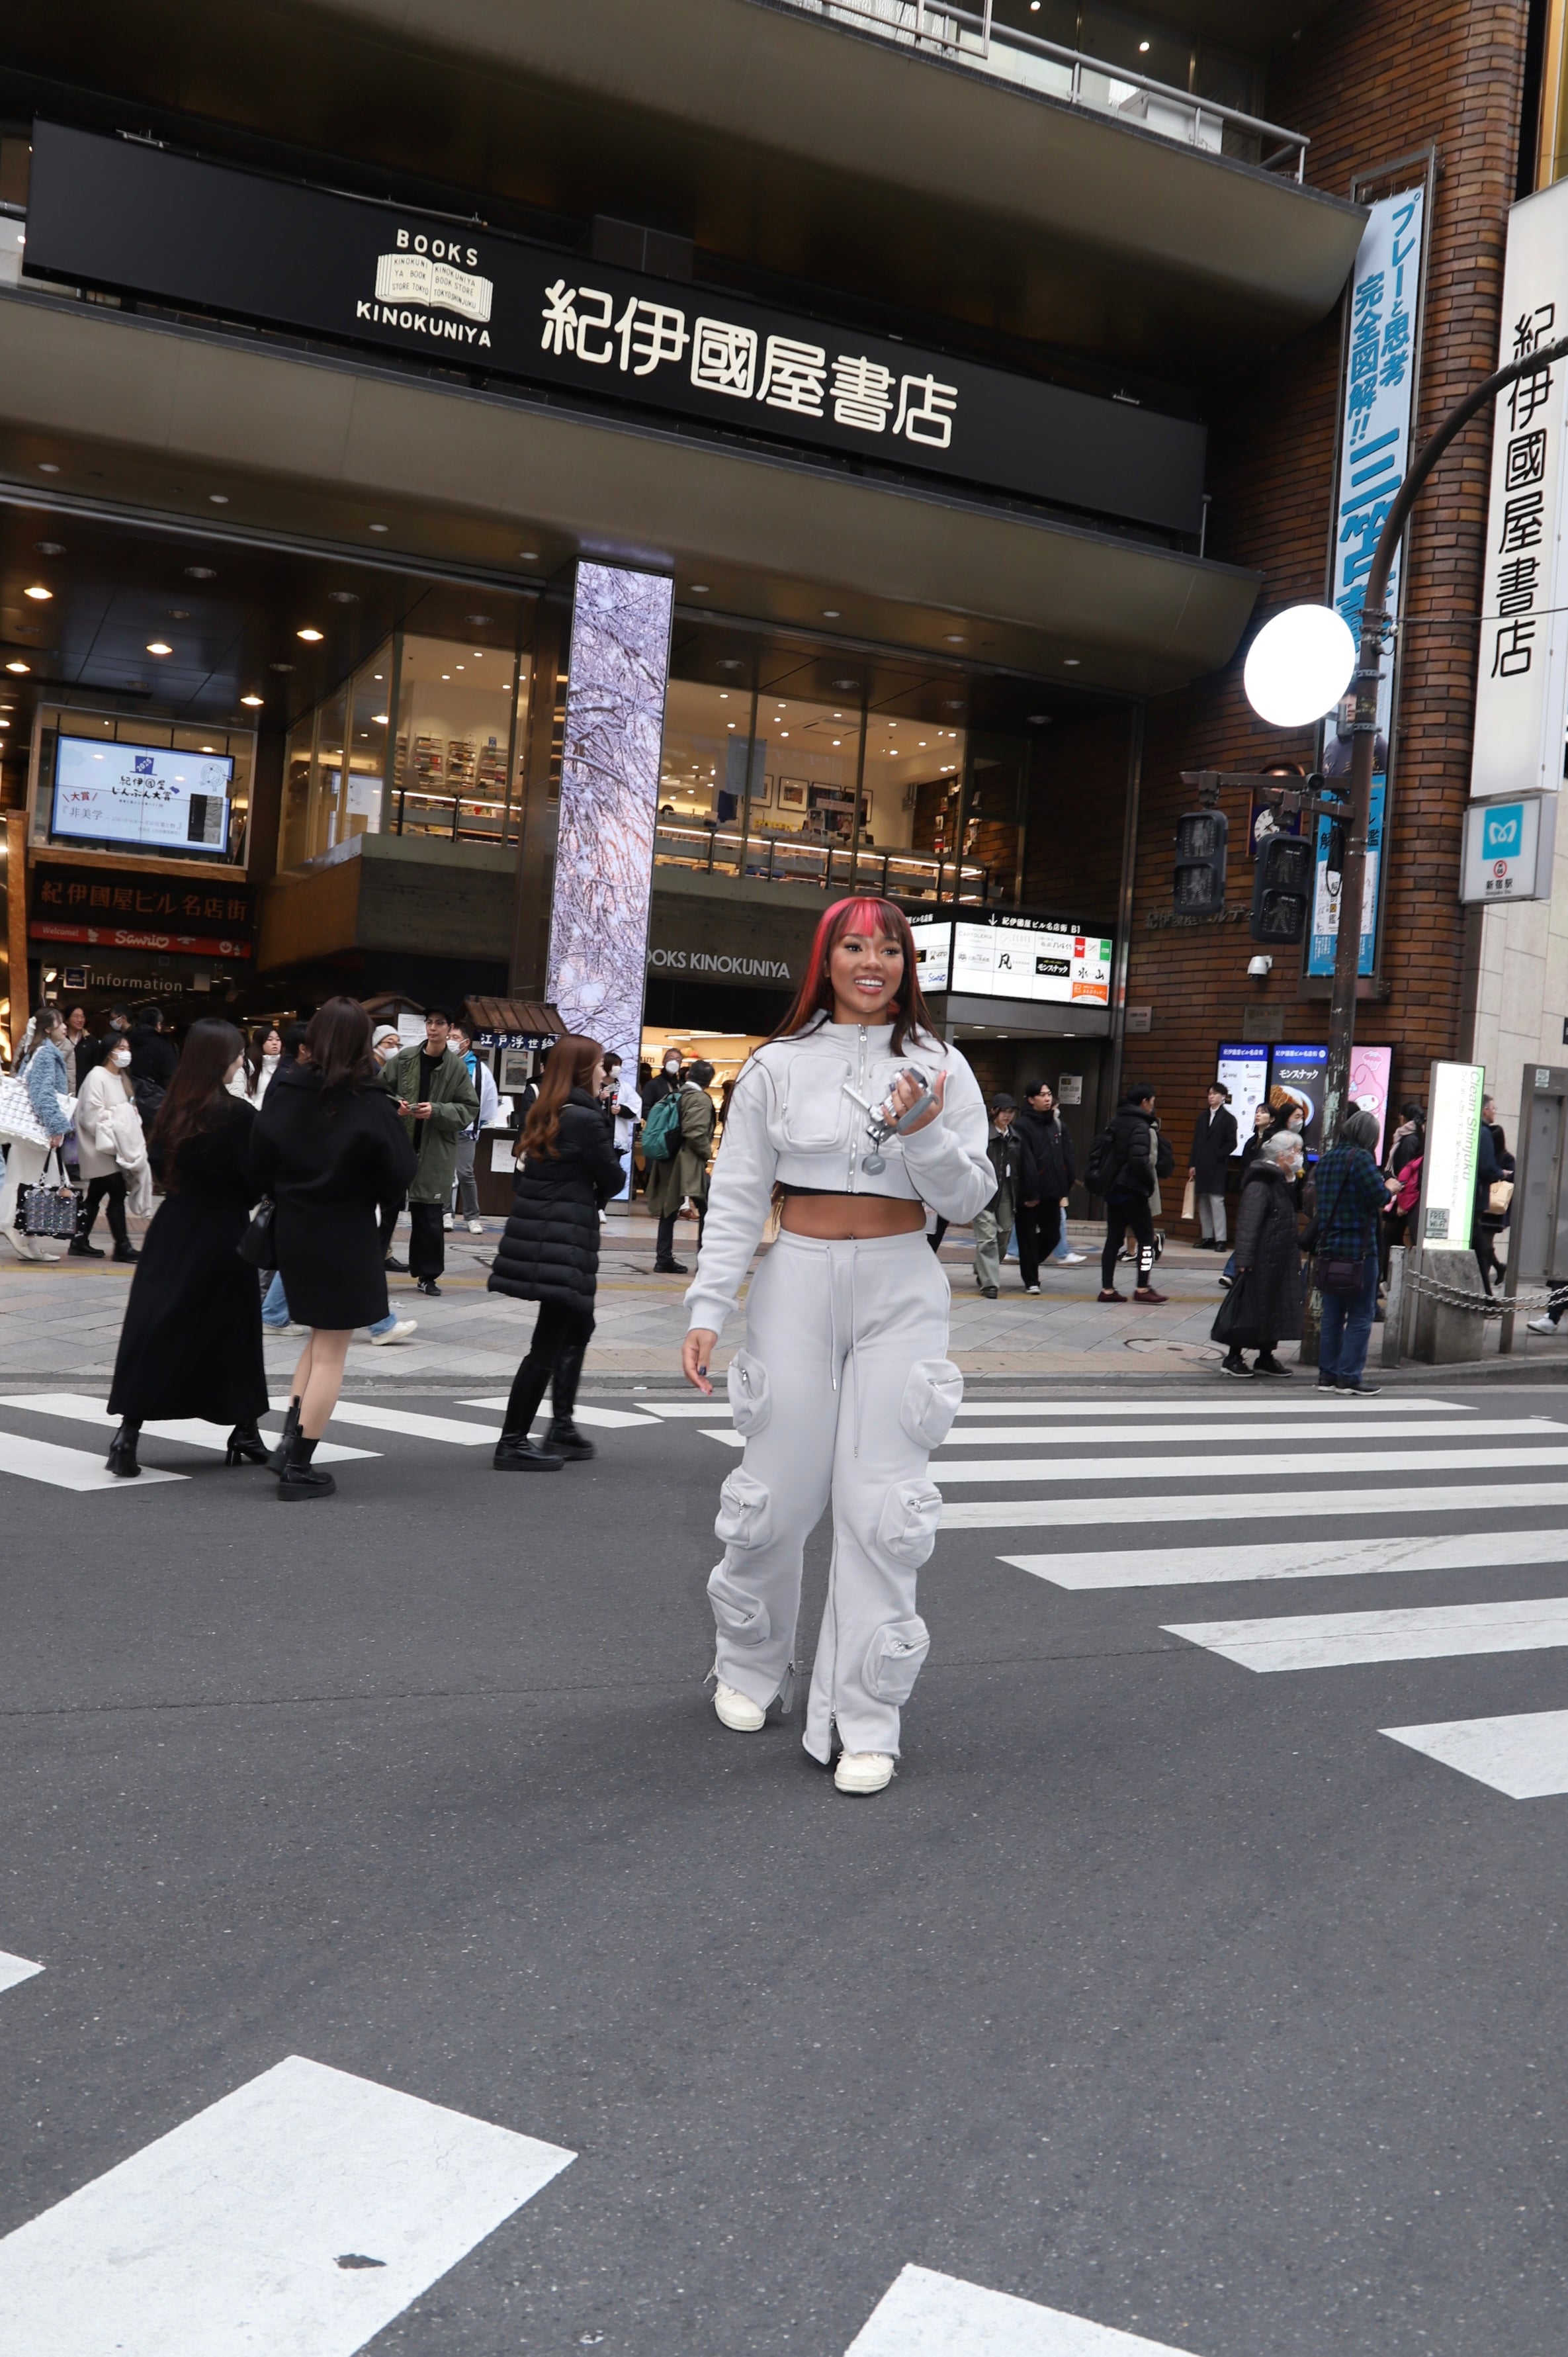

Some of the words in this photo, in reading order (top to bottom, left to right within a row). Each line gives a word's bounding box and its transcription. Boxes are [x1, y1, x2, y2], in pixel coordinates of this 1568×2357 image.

[397, 229, 478, 266] BOOKS
[394, 257, 429, 269] KINOKUNI
[410, 270, 426, 280] BOOK
[435, 265, 476, 287] KINOKUNIYA
[412, 283, 429, 295] TOKYO
[435, 276, 452, 287] BOOK
[455, 282, 474, 296] STORE
[1379, 192, 1421, 386] プレーと思考
[357, 300, 491, 348] KINOKUNIYA
[541, 279, 959, 449] 紀伊國屋書店
[1490, 302, 1555, 679] 紀伊國屋書店
[112, 786, 171, 802] じんぶん大賞
[1486, 878, 1513, 890] 新宿駅
[41, 880, 247, 921] 紀伊國屋ビル名店街
[42, 926, 79, 937] Welcome!
[1002, 916, 1067, 932] 紀伊國屋ビル名店街
[1070, 924, 1081, 934] B1
[114, 929, 169, 948] Sanrio
[690, 953, 791, 979] KINOKUNIYA
[1037, 963, 1068, 974] モンスナック
[90, 973, 183, 992] Information
[480, 1033, 555, 1050] 江戸浮世絵
[1278, 1069, 1319, 1080] モンスナック
[1468, 1071, 1481, 1112] Clean
[1462, 1118, 1477, 1181] Shinjuku
[1429, 1220, 1446, 1228] Wi-Fi
[1430, 1210, 1446, 1220] FREE
